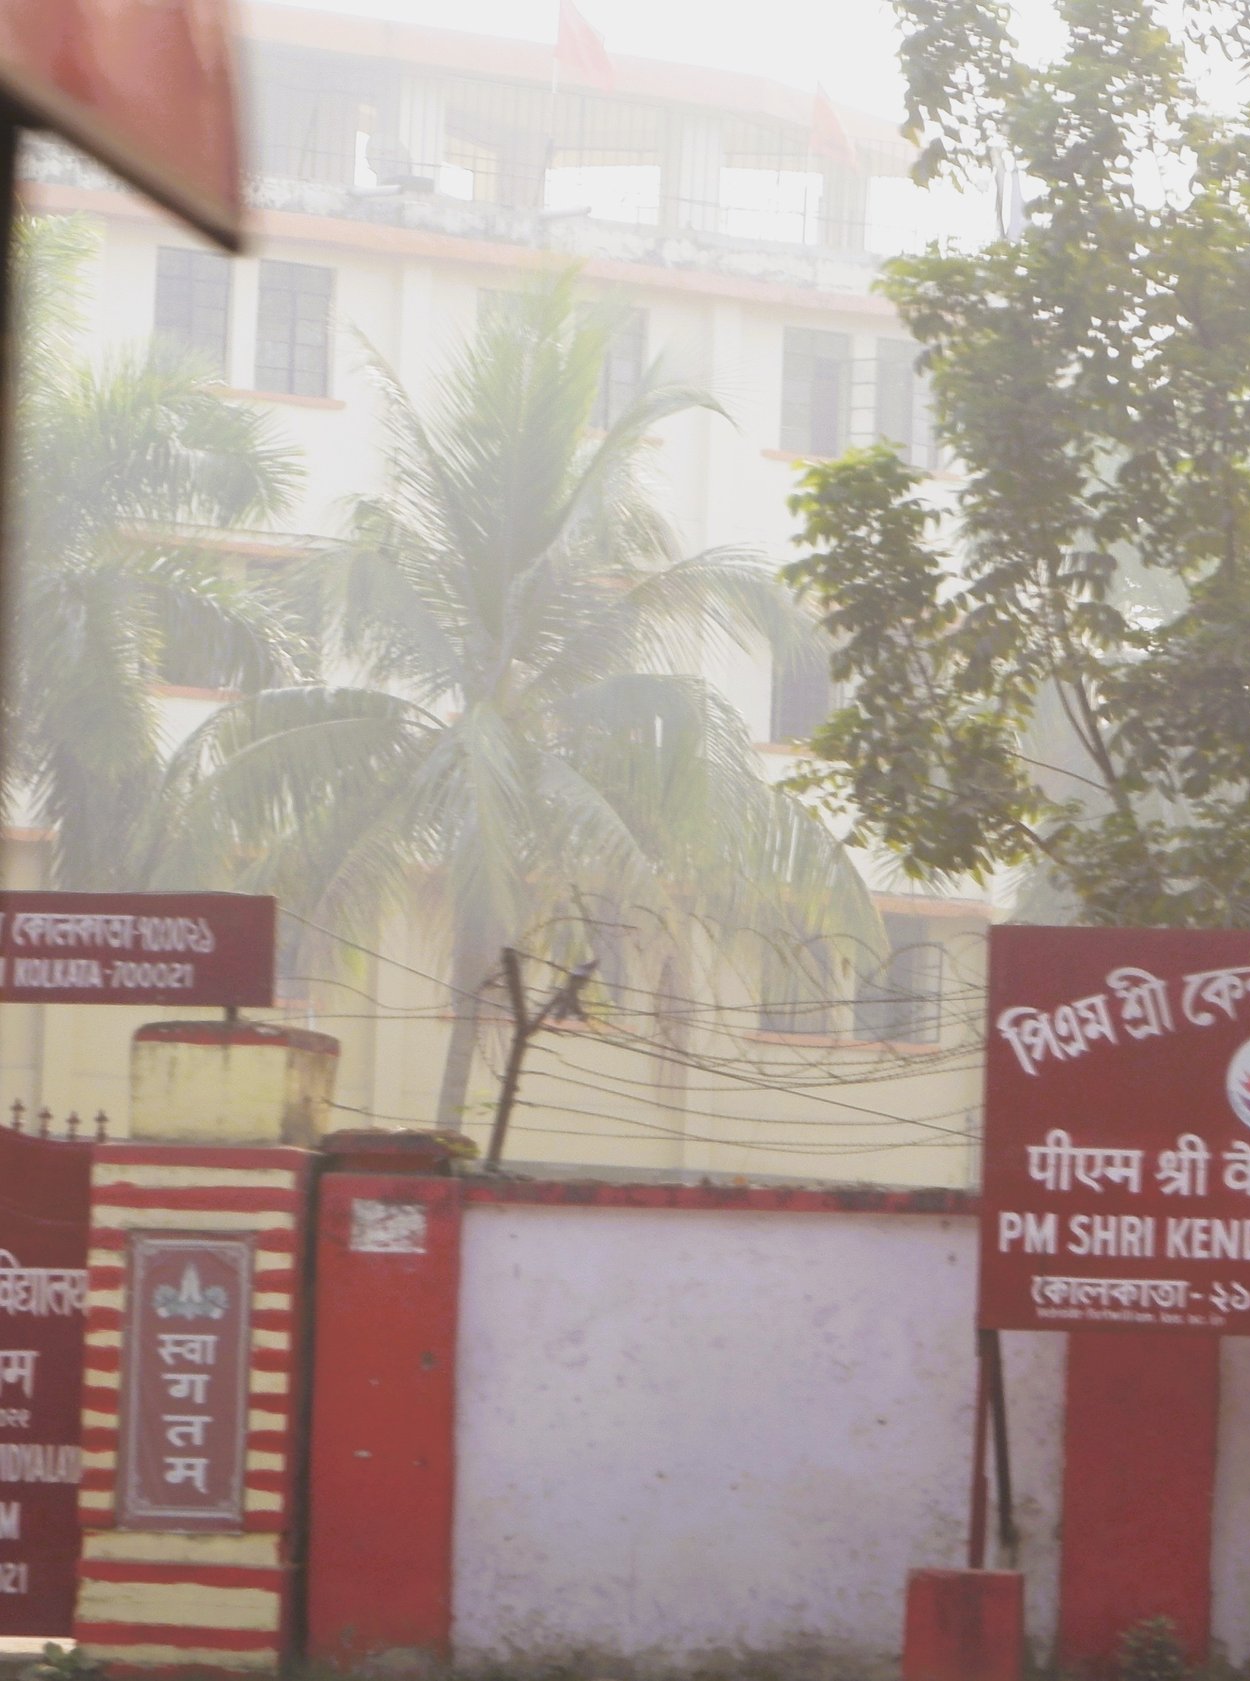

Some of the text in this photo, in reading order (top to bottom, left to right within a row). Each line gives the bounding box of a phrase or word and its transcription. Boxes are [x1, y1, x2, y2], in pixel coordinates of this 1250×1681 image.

[1106, 966, 1174, 1039] শ্রী
[1026, 1128, 1142, 1192] पीएम
[1154, 1133, 1210, 1196] श्री
[998, 1211, 1058, 1255] PM
[1067, 1214, 1155, 1257] SHRI
